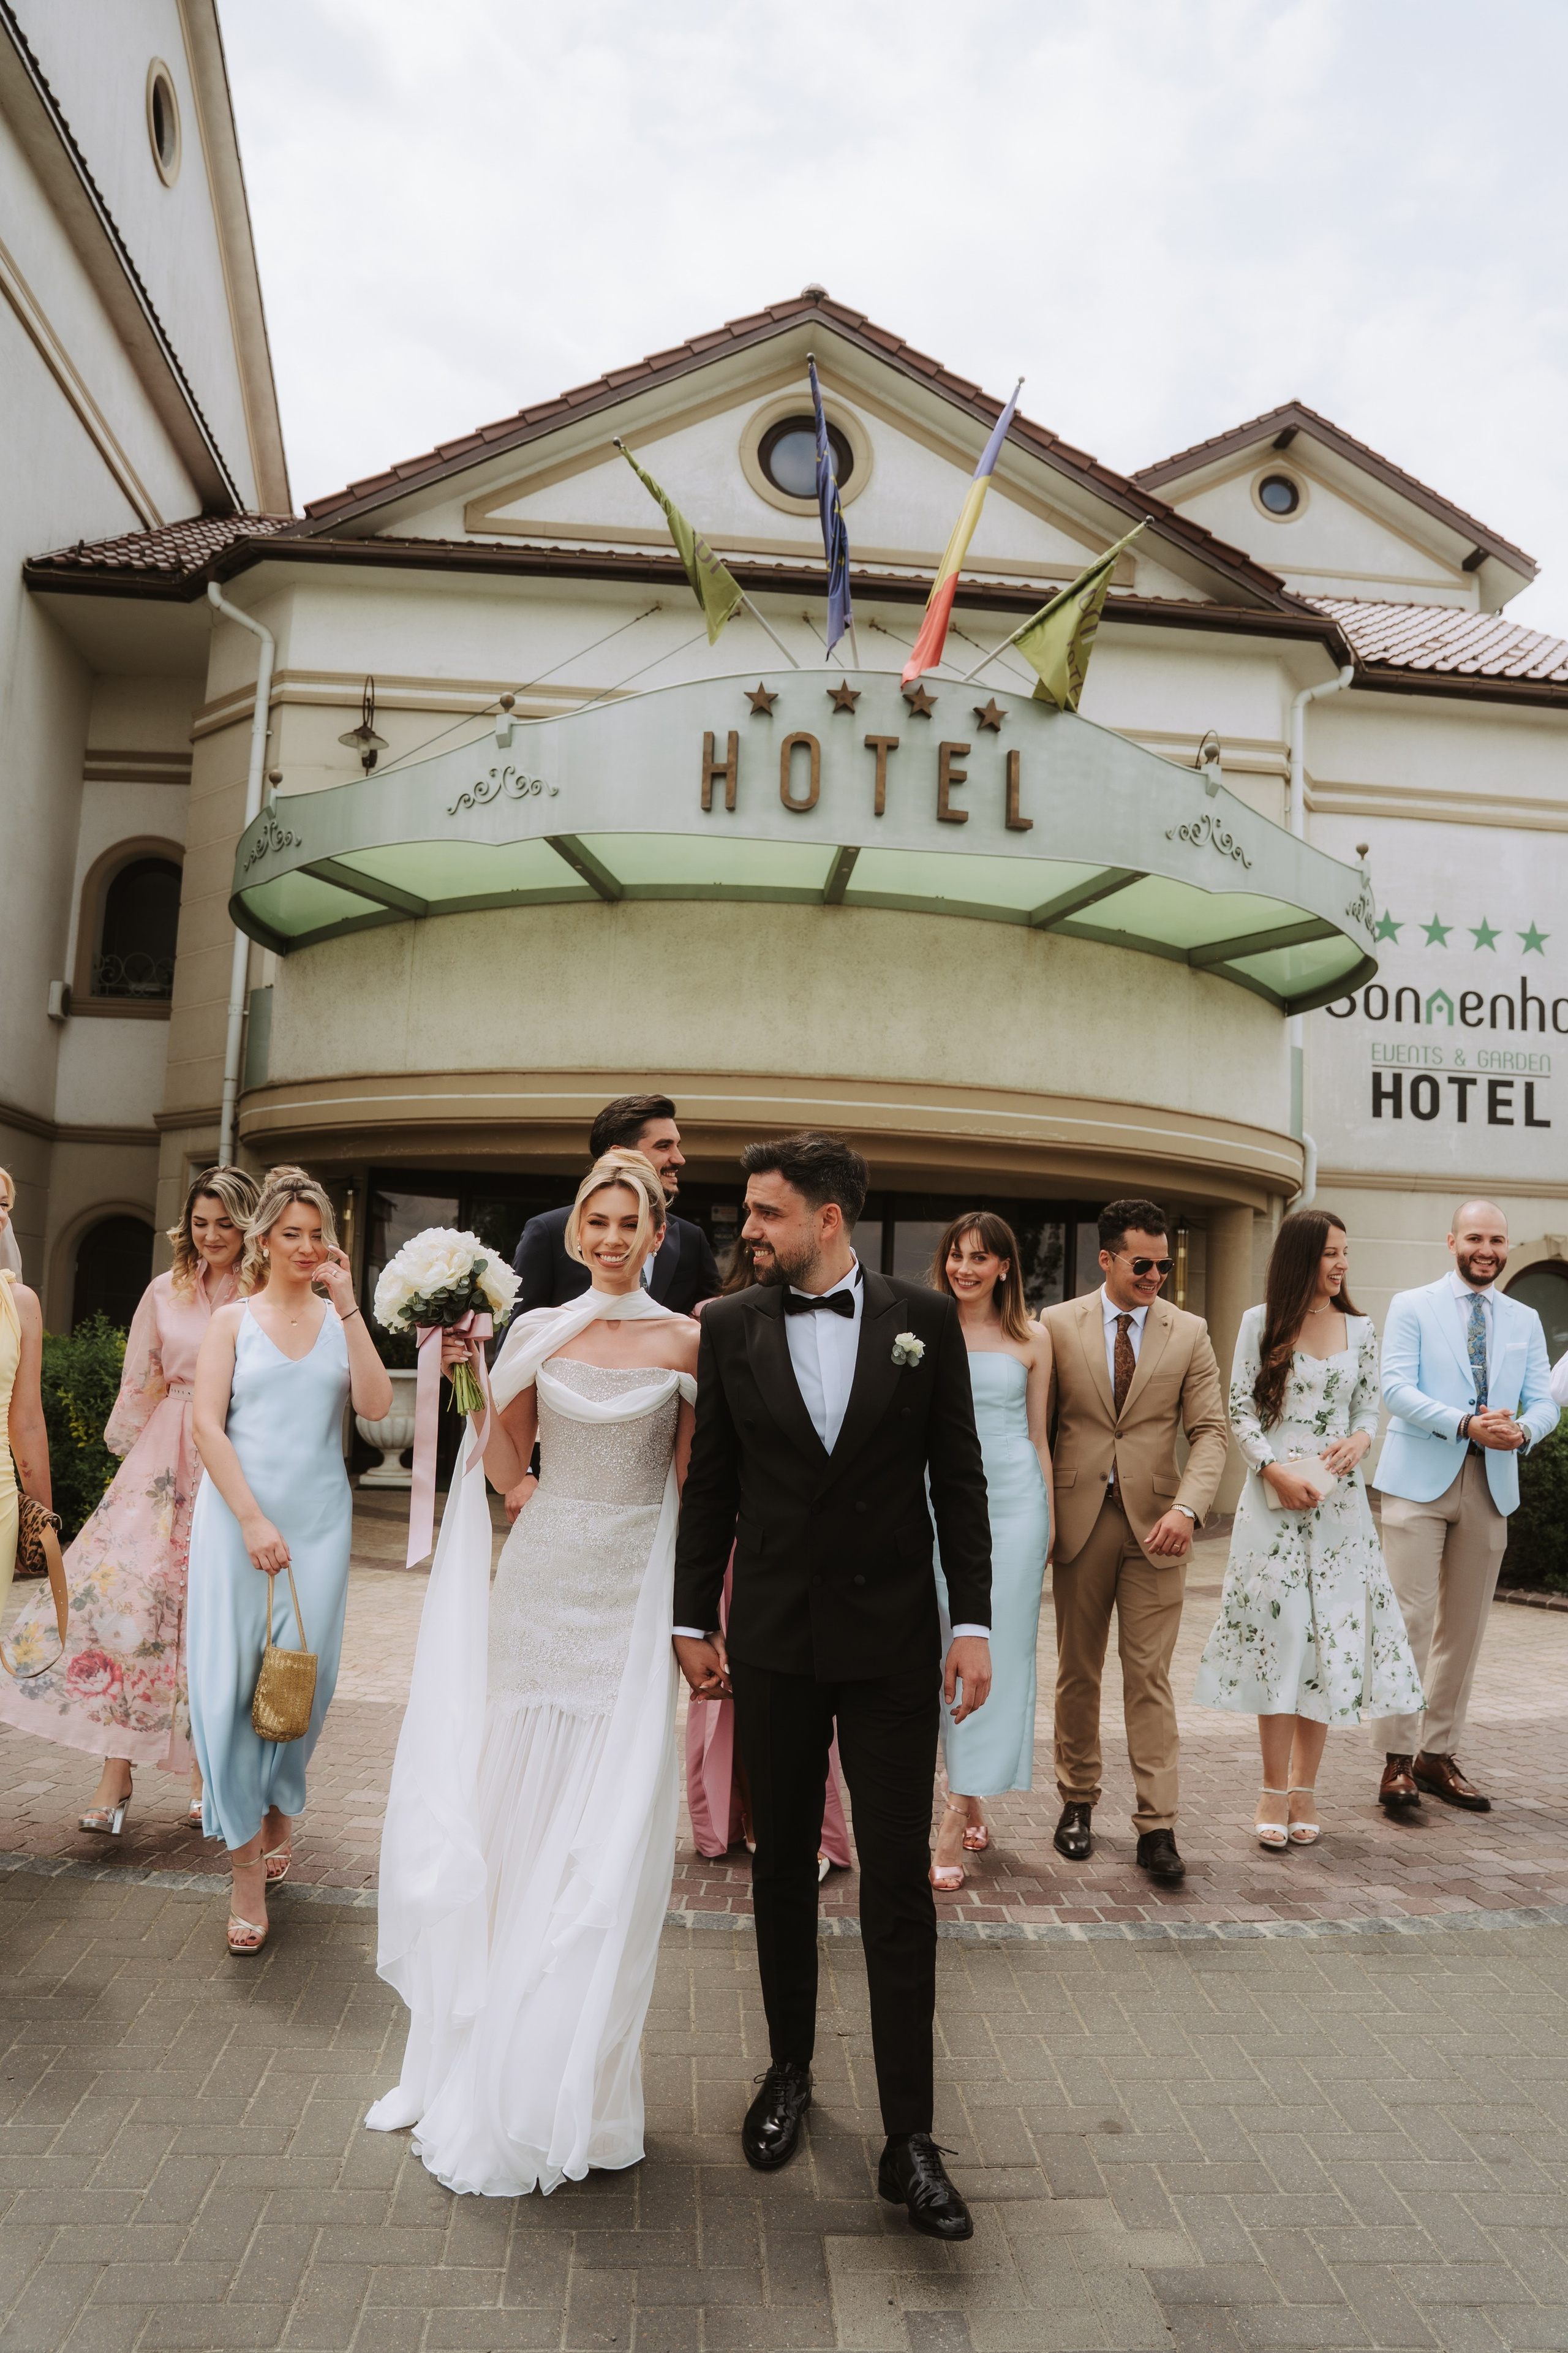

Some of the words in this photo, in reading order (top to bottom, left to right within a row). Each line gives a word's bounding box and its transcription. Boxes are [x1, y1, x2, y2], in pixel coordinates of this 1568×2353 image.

[1066, 640, 1084, 707] OTE
[701, 730, 1033, 831] HOTEL
[1371, 1042, 1443, 1065] EVENTS
[1454, 1048, 1466, 1067] &
[1477, 1049, 1551, 1072] GARDEN
[1372, 1071, 1551, 1128] HOTEL
